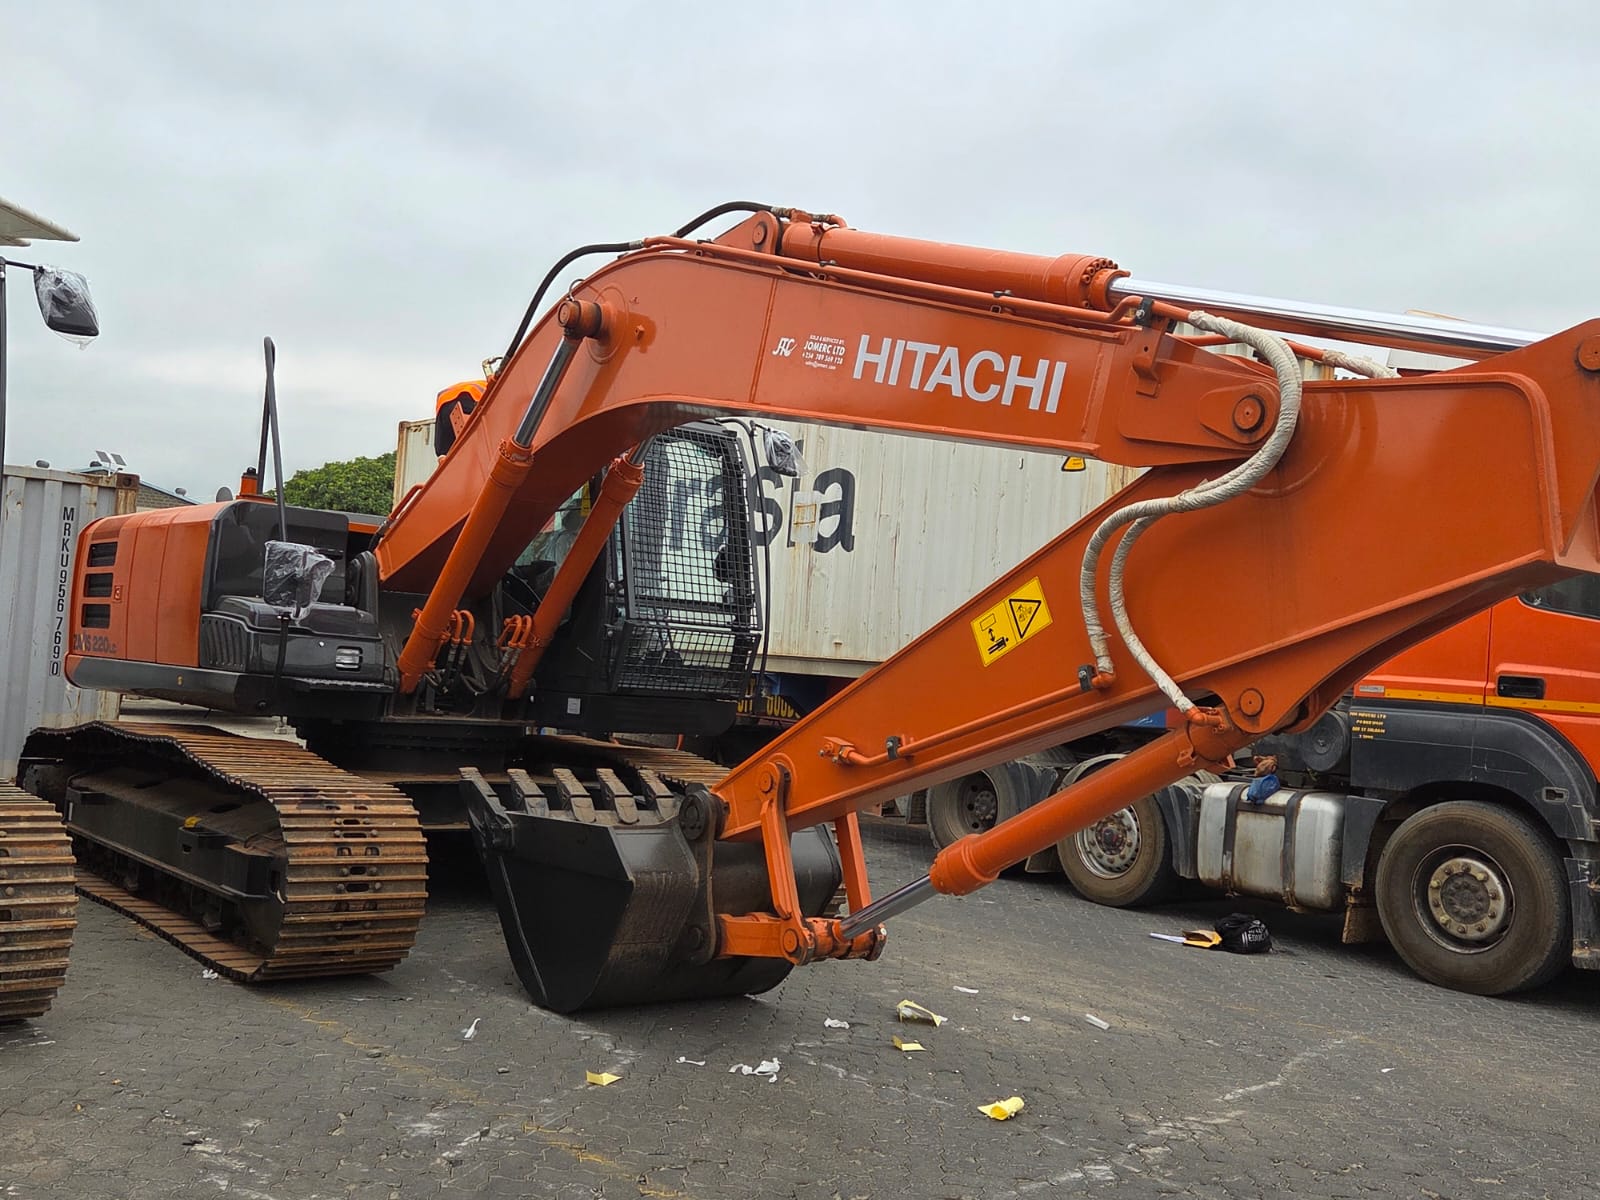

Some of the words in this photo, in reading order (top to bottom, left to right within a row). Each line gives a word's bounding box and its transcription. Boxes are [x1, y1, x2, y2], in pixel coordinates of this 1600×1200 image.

[804, 341, 832, 354] JOMERC
[832, 346, 845, 356] LTD
[852, 334, 1067, 414] HITACHI
